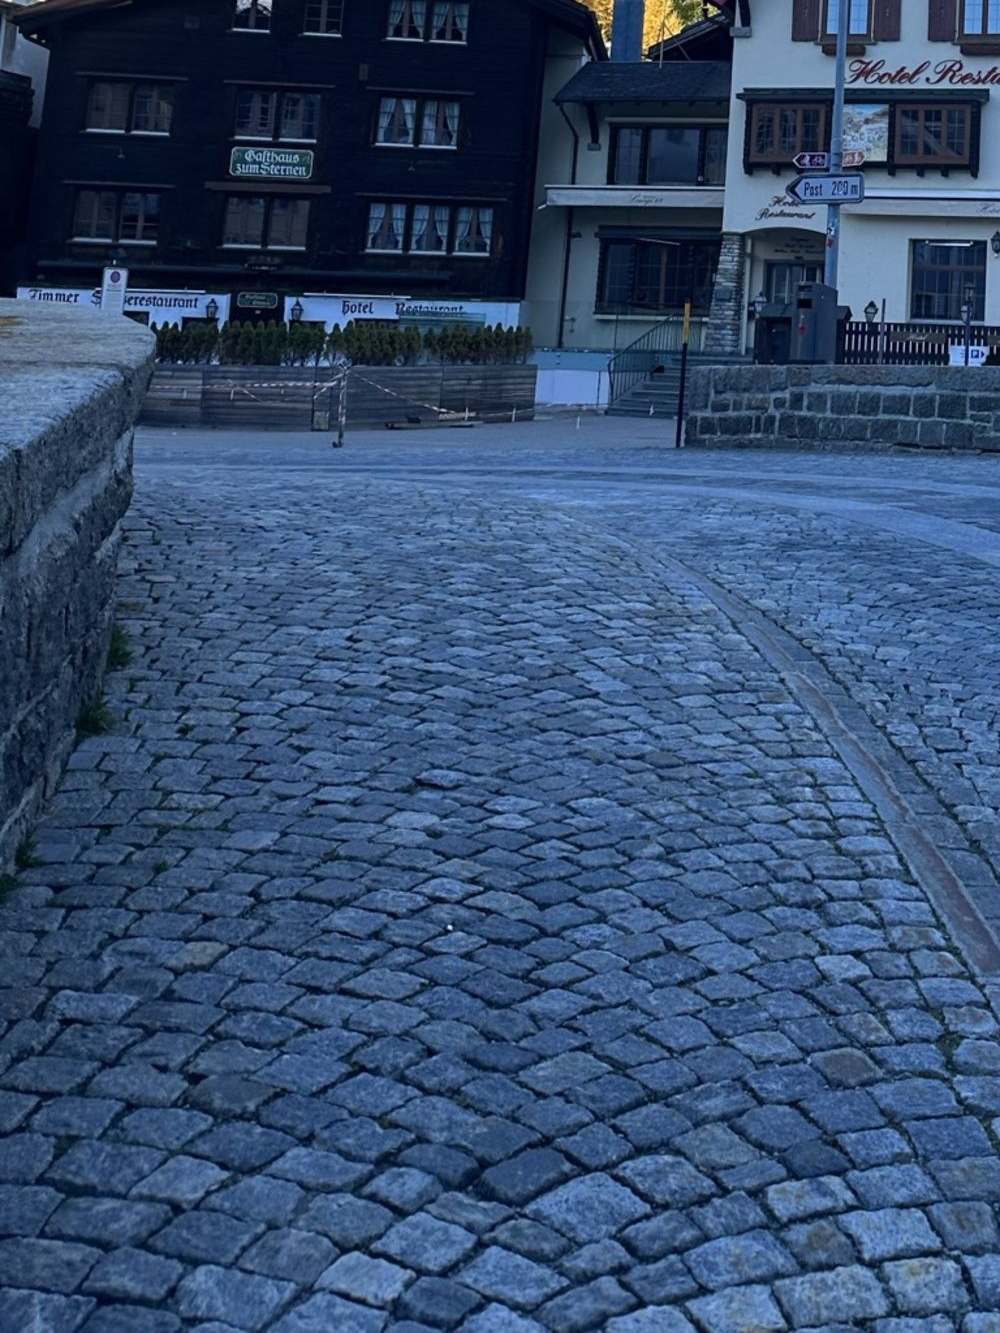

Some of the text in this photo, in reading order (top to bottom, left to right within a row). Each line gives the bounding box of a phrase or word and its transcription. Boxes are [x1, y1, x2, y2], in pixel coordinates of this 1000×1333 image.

[844, 59, 931, 85] Hotel
[235, 163, 307, 176] zum Sternen
[804, 180, 859, 196] Post 200 m
[755, 208, 816, 220] Restaurant
[28, 288, 80, 303] Zimmer
[341, 300, 375, 316] Hotel
